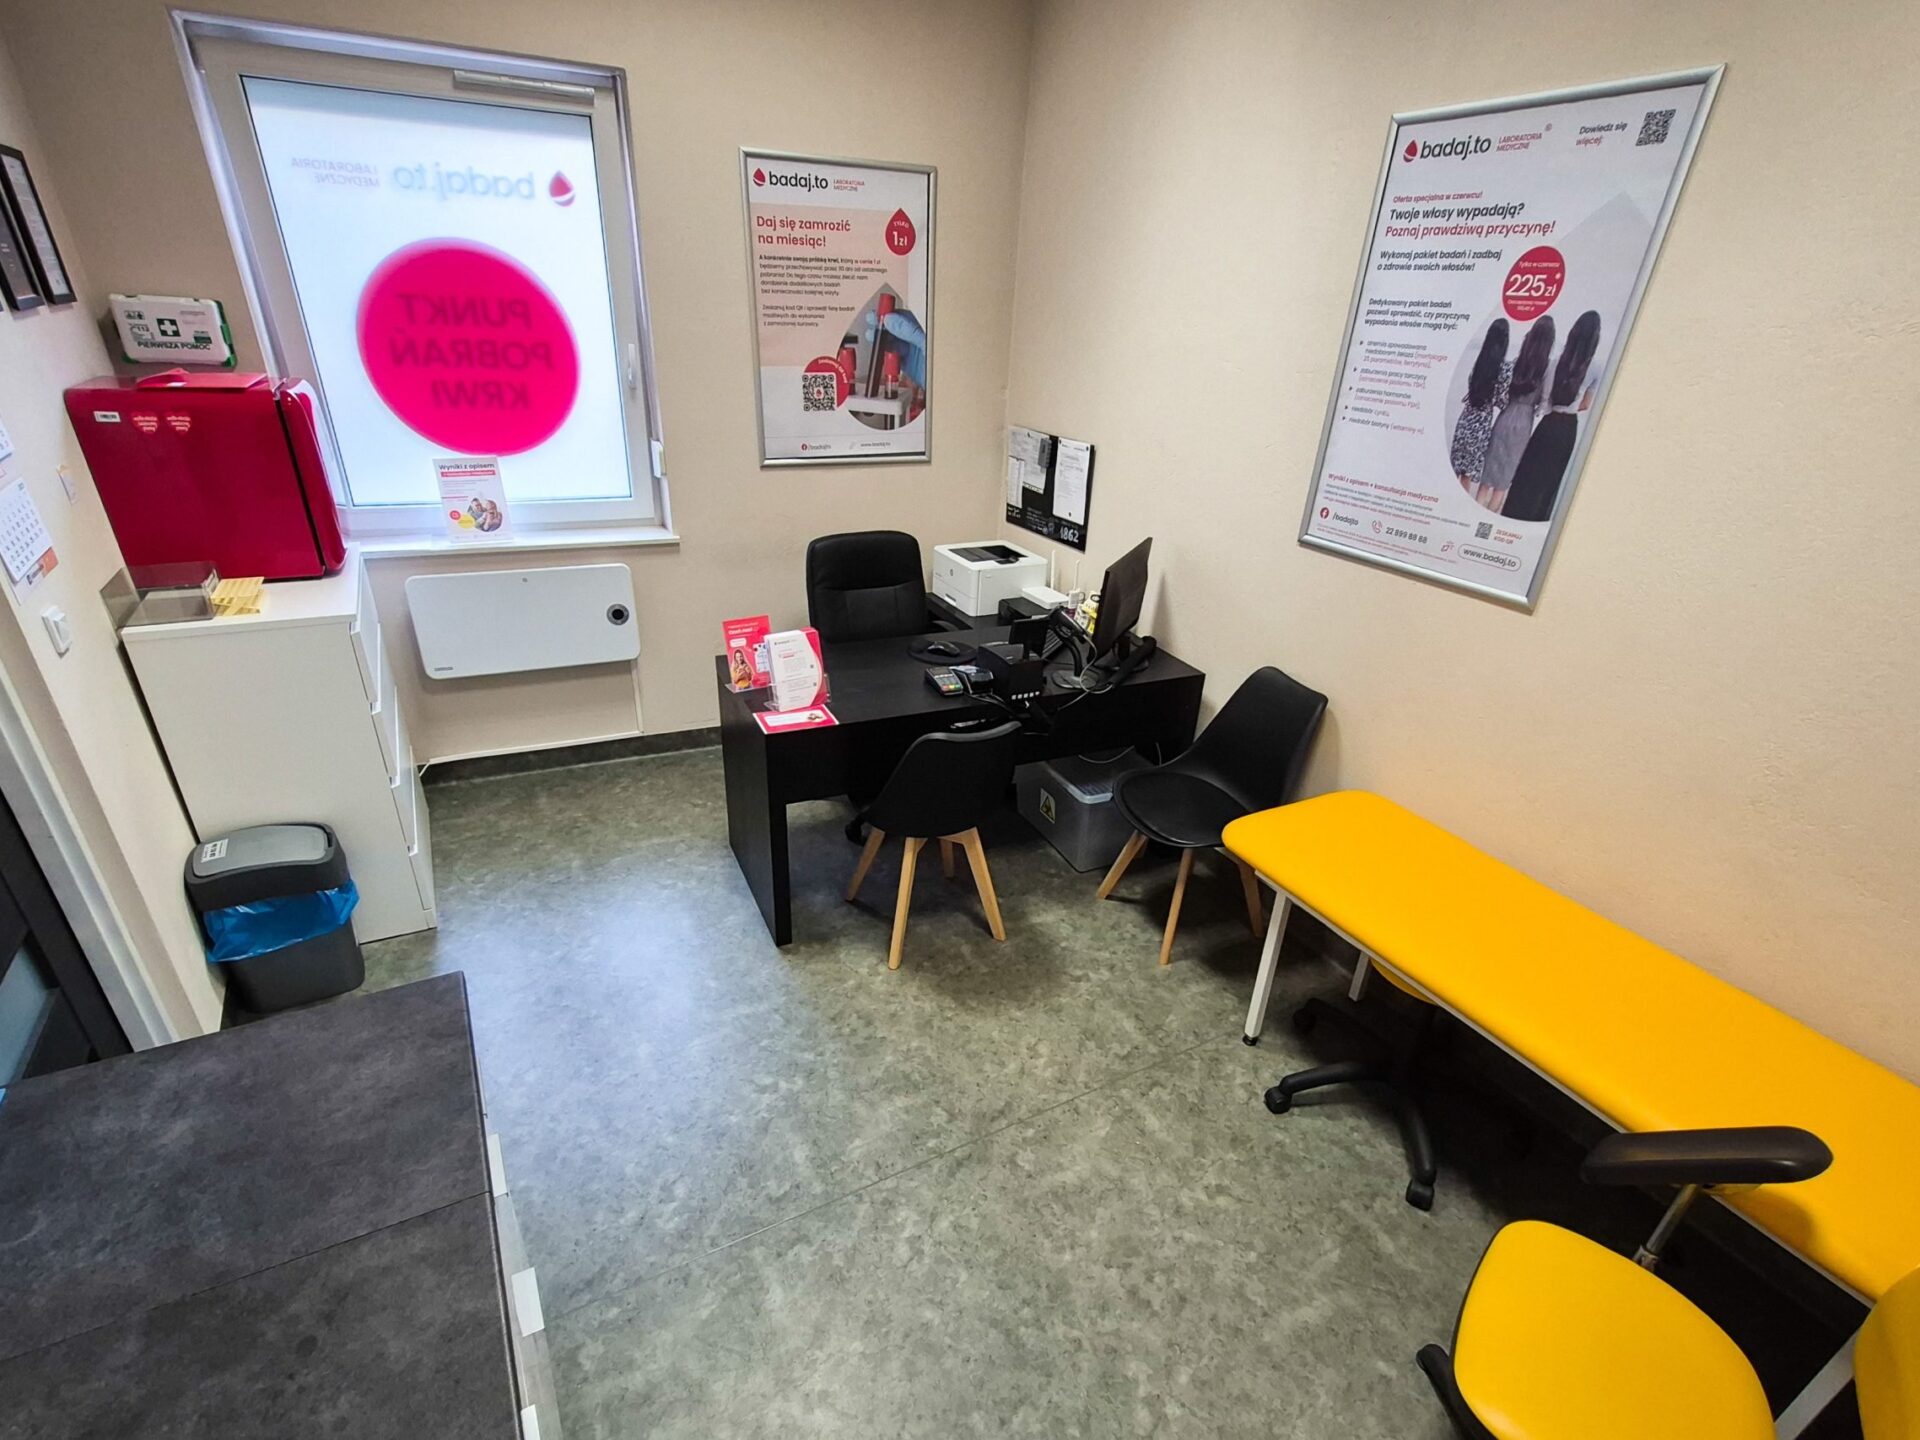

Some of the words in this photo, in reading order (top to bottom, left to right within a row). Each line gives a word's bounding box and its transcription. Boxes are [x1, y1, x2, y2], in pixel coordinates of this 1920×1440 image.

[1579, 123, 1613, 134] Dowiedz
[1614, 122, 1628, 132] się
[1498, 132, 1542, 144] LABORATORIA
[1420, 135, 1492, 160] badaj.to
[1496, 142, 1530, 152] MEDYCZNE
[769, 171, 828, 192] badaj.to
[1414, 194, 1444, 203] specjalna
[1452, 192, 1483, 200] czerwcu!
[1390, 208, 1420, 223] Twoje
[1422, 206, 1454, 221] włosy
[1456, 202, 1525, 220] wypadają?
[756, 216, 777, 231] Daj
[779, 217, 796, 231] się
[798, 219, 851, 232] zamrozić
[1385, 225, 1421, 240] Poznaj
[1421, 222, 1484, 239] prawdziwą
[1485, 220, 1556, 238] przyczynę!
[758, 234, 773, 244] na
[776, 234, 826, 248] miesiąc!
[1380, 250, 1413, 261] Wykonaj
[1413, 250, 1438, 260] pakiet
[1440, 249, 1466, 259] badań
[1472, 249, 1502, 261] zadbaj
[1383, 262, 1412, 271] zdrowie
[1413, 262, 1440, 271] swoich
[1442, 262, 1475, 271] włosów!
[1369, 298, 1407, 308] Dedykowany
[1408, 300, 1429, 308] pakiet
[1435, 312, 1470, 322] przyczyną
[1423, 322, 1441, 331] mogą
[1443, 322, 1458, 331] być:
[1374, 482, 1407, 497] konsultacja
[1407, 491, 1439, 503] medyczna
[1464, 548, 1516, 567] www.badaj.to
